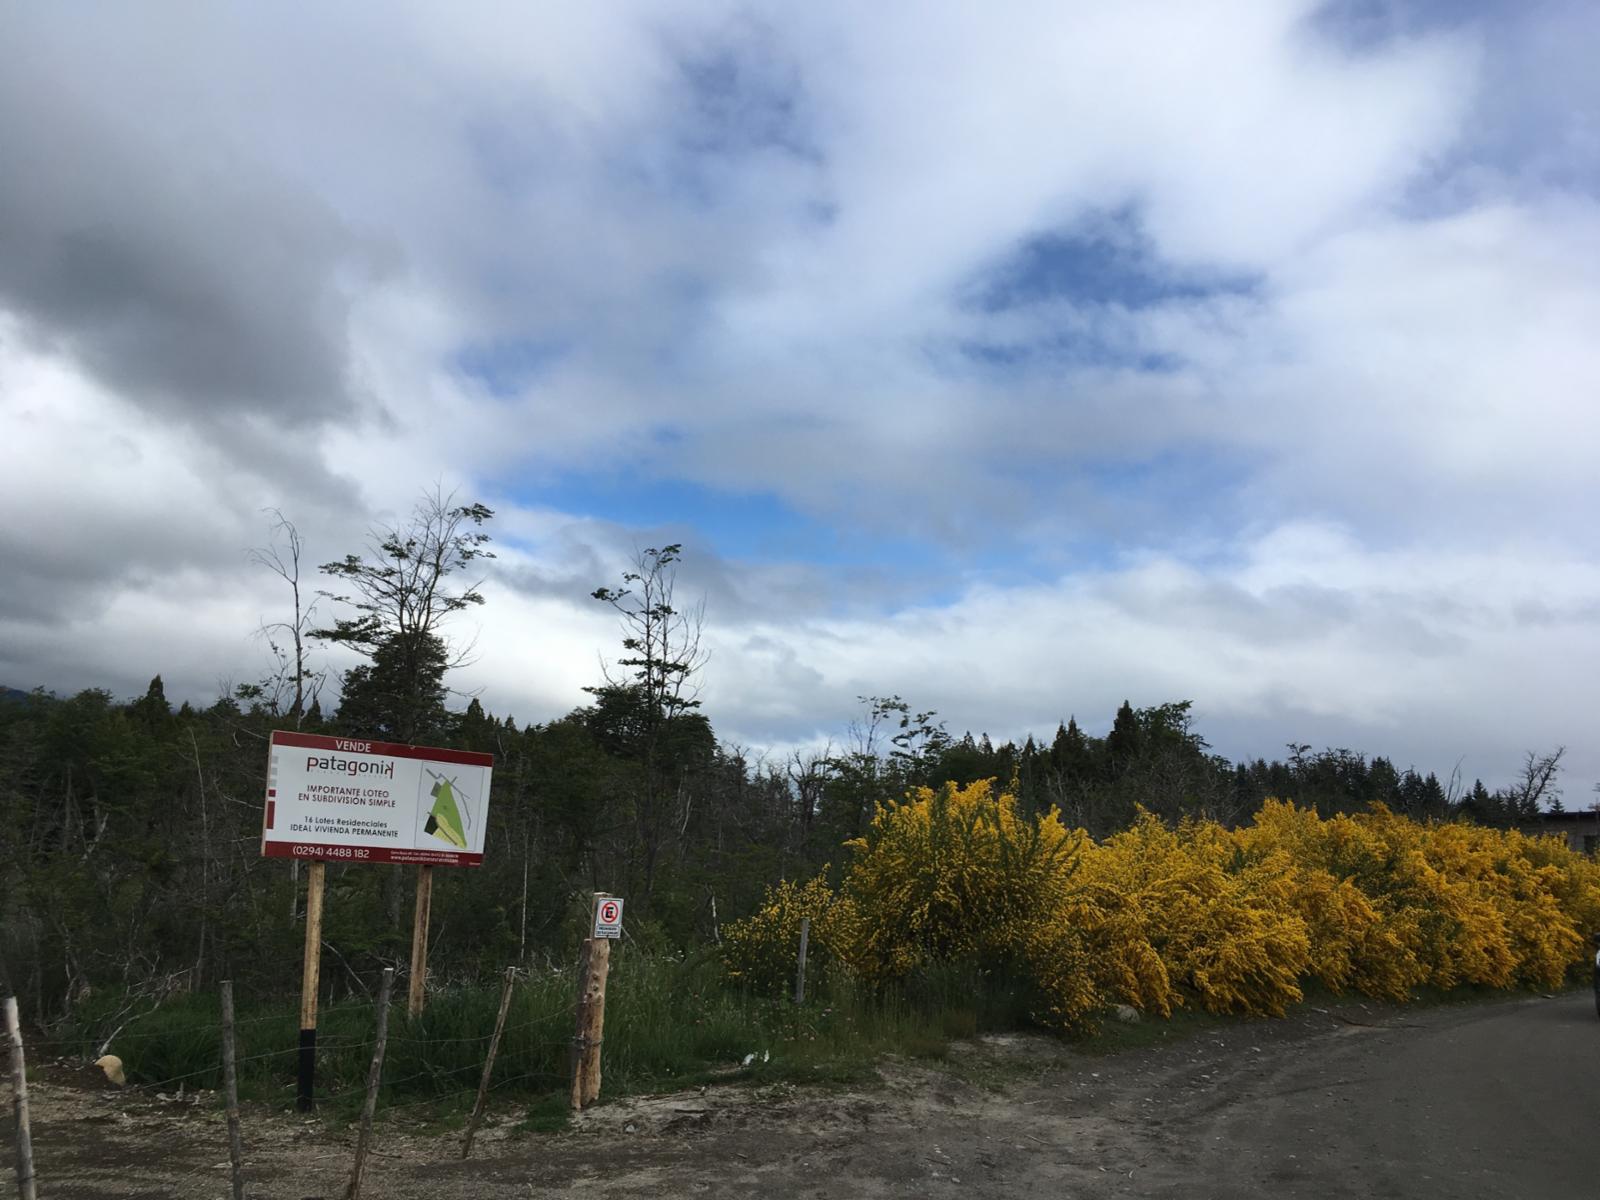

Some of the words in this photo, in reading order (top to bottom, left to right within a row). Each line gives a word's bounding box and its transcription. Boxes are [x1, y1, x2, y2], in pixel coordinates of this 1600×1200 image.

[336, 740, 372, 752] VENDE
[306, 756, 394, 779] patagonik
[307, 785, 360, 796] IMPORTANTE
[363, 789, 390, 798] LOTEO
[298, 793, 310, 801] EN
[368, 799, 396, 808] SIMPLE
[315, 816, 334, 825] Lotes
[336, 818, 388, 828] Residenciales
[290, 824, 312, 832] IDEAL
[314, 826, 350, 834] VIVIENDA
[352, 828, 399, 838] PERMANENTE
[292, 846, 324, 856] (0294)
[326, 848, 352, 858] 4488
[354, 848, 370, 858] 182
